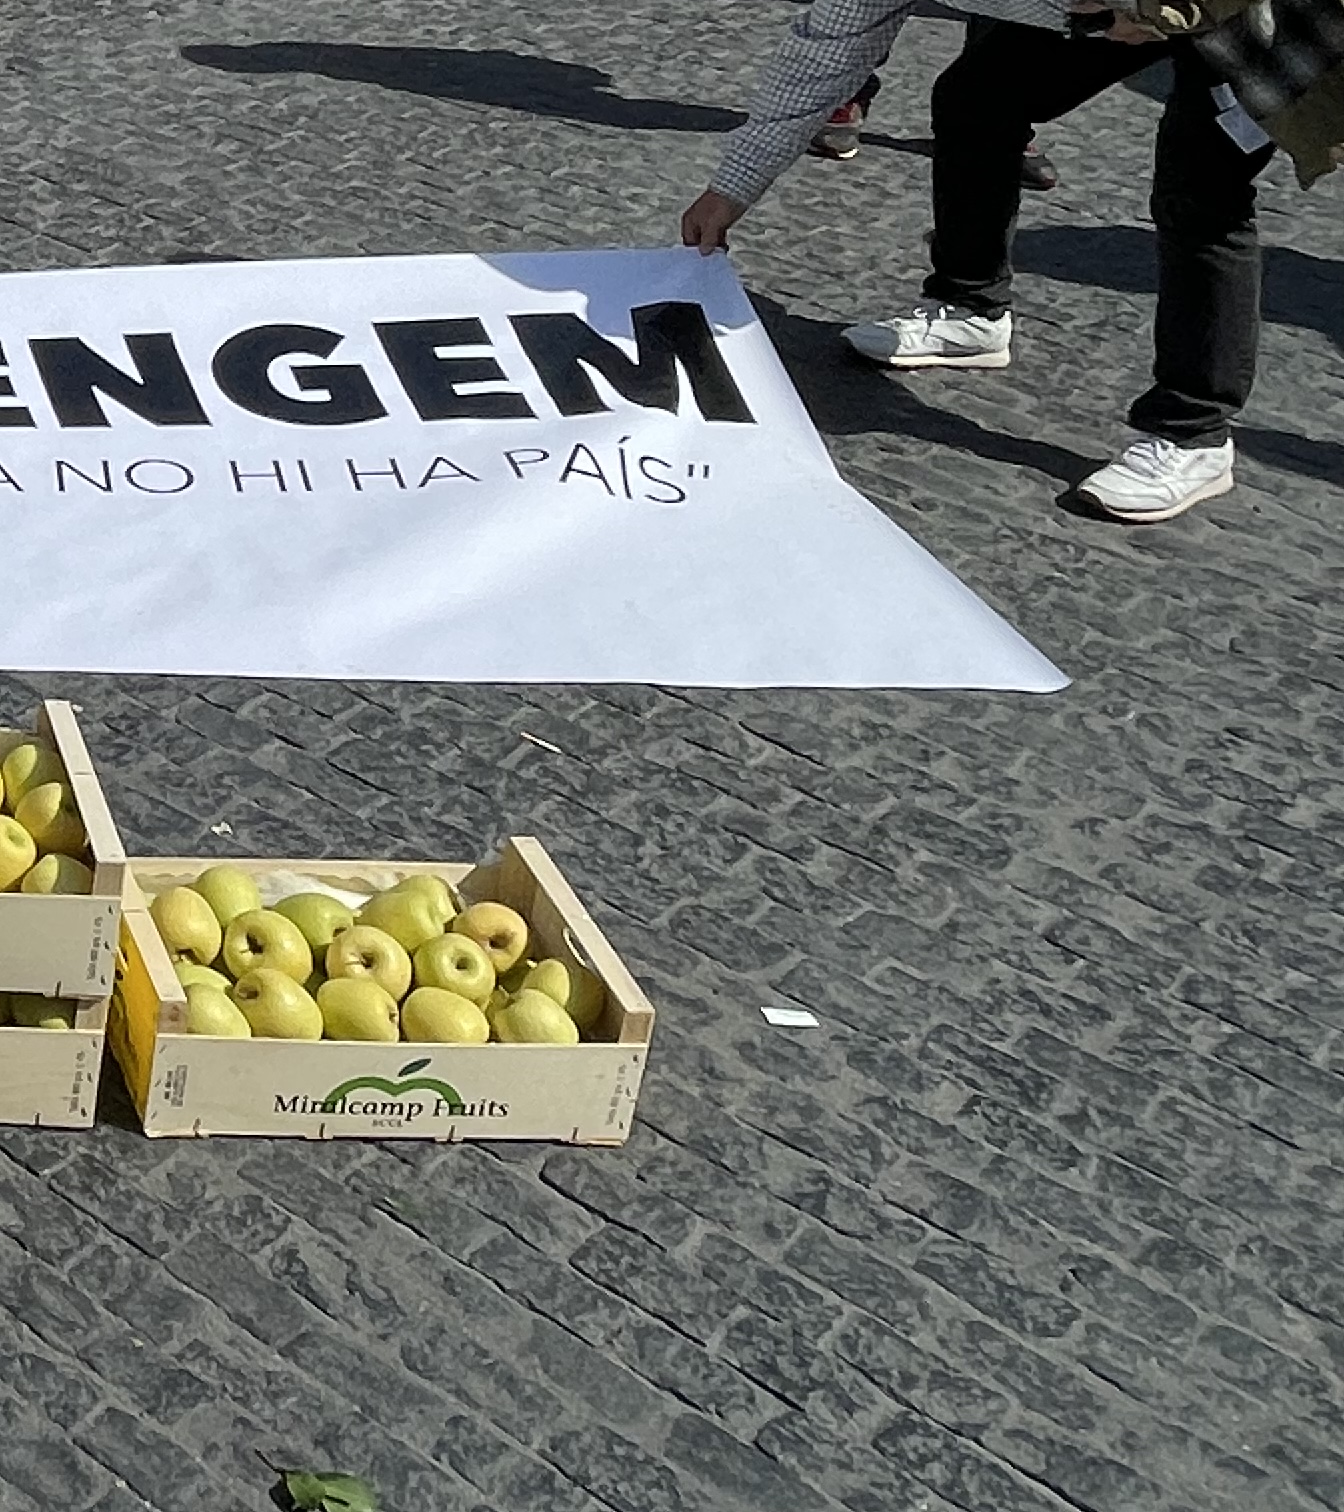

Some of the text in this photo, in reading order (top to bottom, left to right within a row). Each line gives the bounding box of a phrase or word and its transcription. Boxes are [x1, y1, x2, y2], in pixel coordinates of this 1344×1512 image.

[56, 459, 195, 494] NO
[229, 459, 313, 493] HI
[345, 456, 481, 492] HA
[273, 1094, 510, 1123] Miralcamp Fruits
